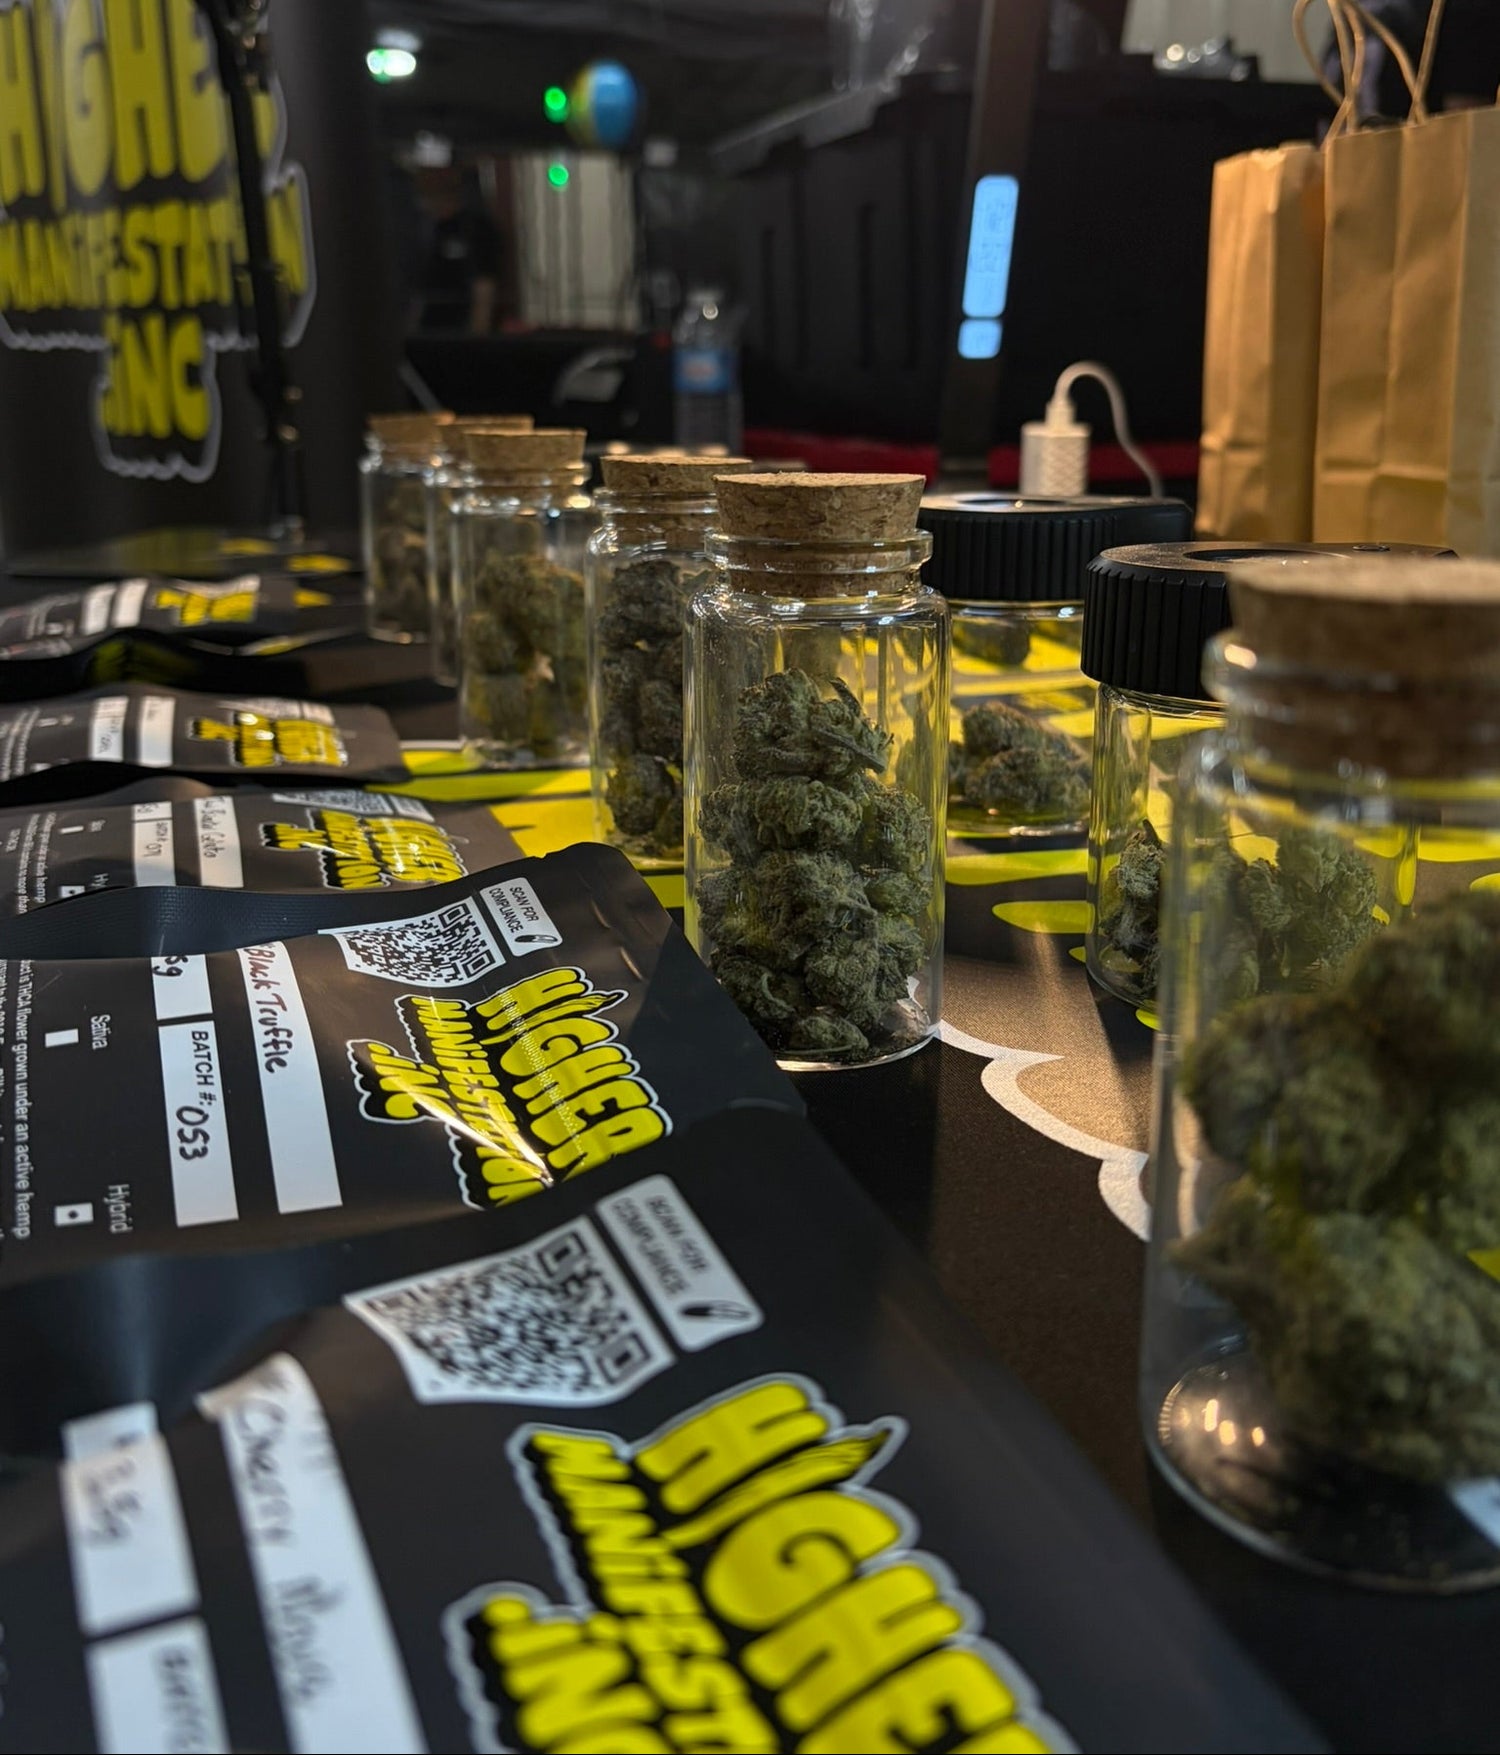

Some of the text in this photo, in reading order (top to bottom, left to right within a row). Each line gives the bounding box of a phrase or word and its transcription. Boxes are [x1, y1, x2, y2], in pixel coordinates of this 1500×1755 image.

[0, 0, 278, 213] HIGHE
[489, 887, 524, 933] COMPLIANCE
[509, 886, 540, 922] SCAN FOR
[17, 981, 33, 1008] THCA
[243, 945, 294, 1074] Black Truffle
[16, 1008, 32, 1041] flower
[91, 1014, 111, 1050] Sativa
[11, 1042, 28, 1081] grown
[191, 1030, 214, 1086] BATCH
[15, 1082, 33, 1121] under
[15, 1123, 29, 1141] an
[15, 1144, 34, 1190] active
[11, 1192, 35, 1239] hemp
[104, 1184, 133, 1234] Hybrid
[632, 1380, 1053, 1753] HIGHE
